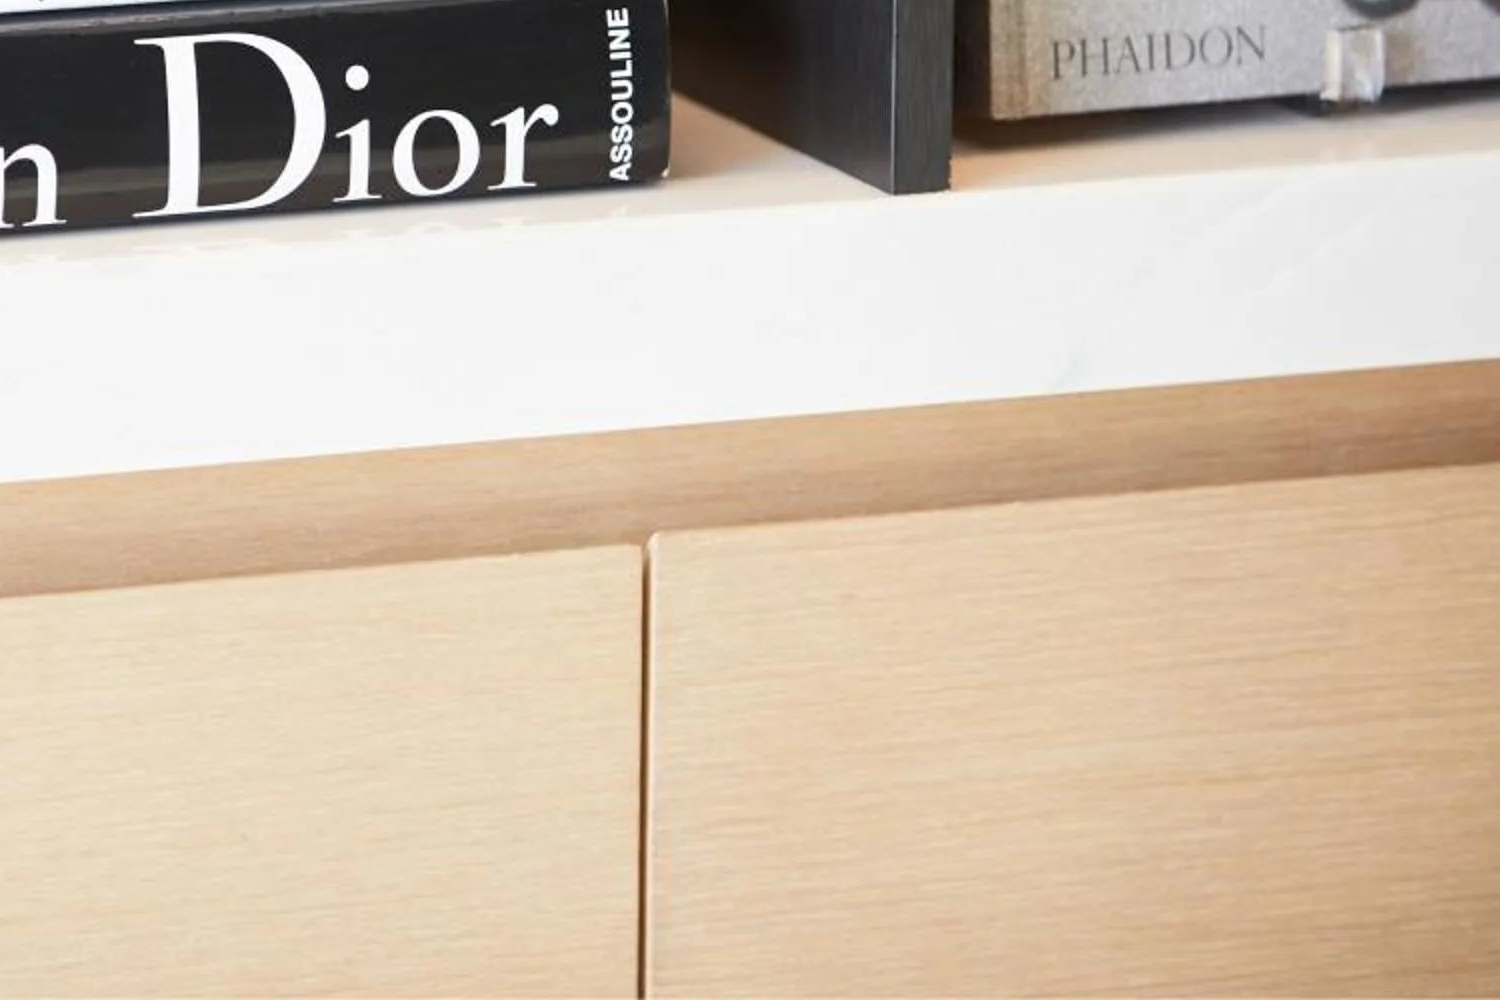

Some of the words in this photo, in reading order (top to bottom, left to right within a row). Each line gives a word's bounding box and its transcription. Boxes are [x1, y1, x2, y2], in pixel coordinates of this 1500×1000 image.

[132, 32, 560, 218] Dior
[605, 7, 632, 182] ASSOULINE
[1052, 25, 1267, 81] PHAIDON
